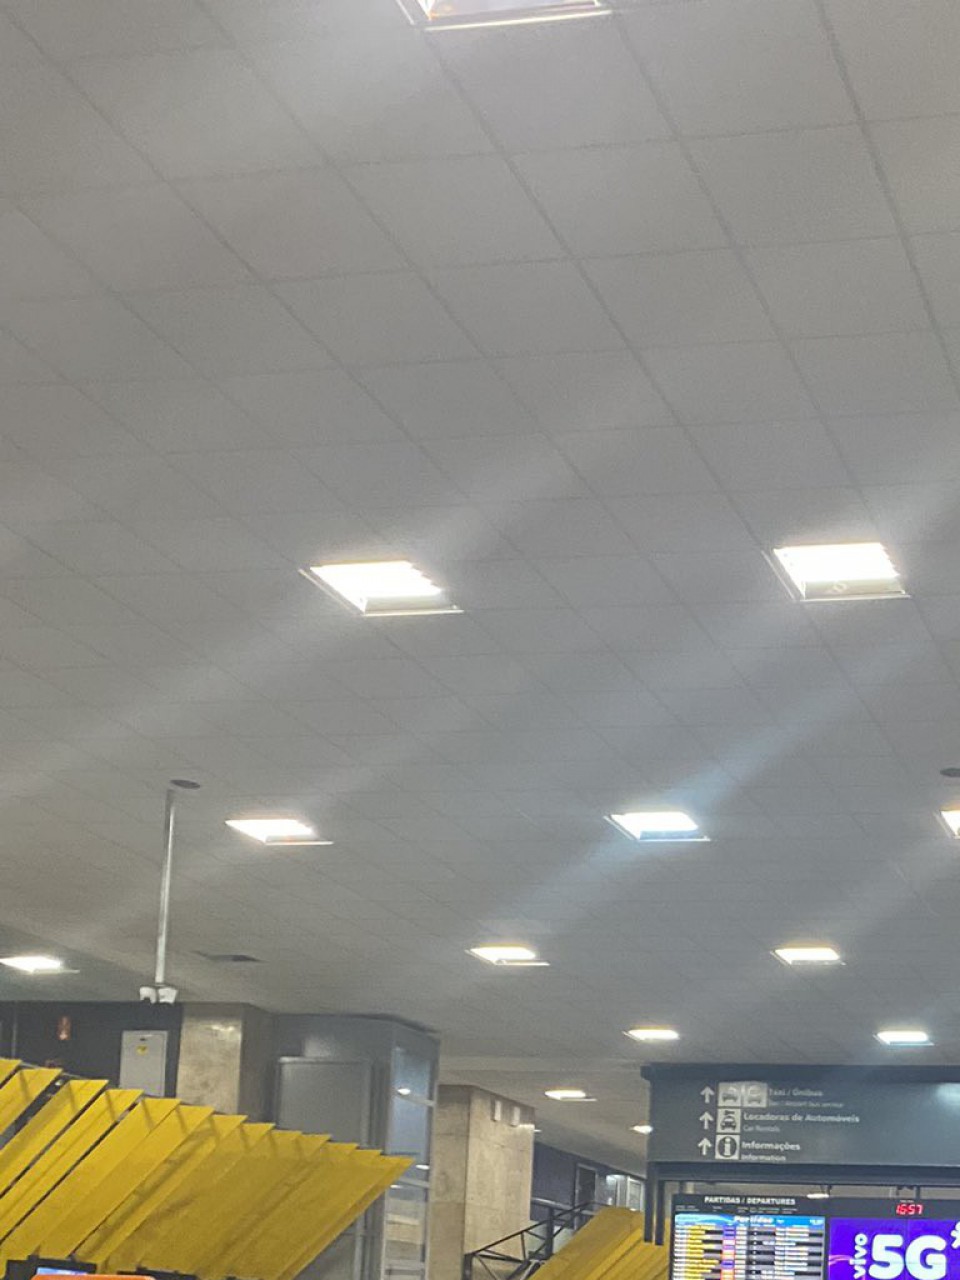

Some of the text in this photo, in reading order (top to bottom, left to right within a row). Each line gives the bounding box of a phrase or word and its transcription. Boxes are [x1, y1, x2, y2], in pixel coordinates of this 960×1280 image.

[743, 1112, 860, 1123] Locadoras de Automóveis
[741, 1140, 801, 1151] Informações
[704, 1196, 741, 1204] PARTIDAS
[746, 1197, 796, 1206] DEPARTURES
[849, 1233, 868, 1280] vivo
[868, 1234, 947, 1280] 5G
